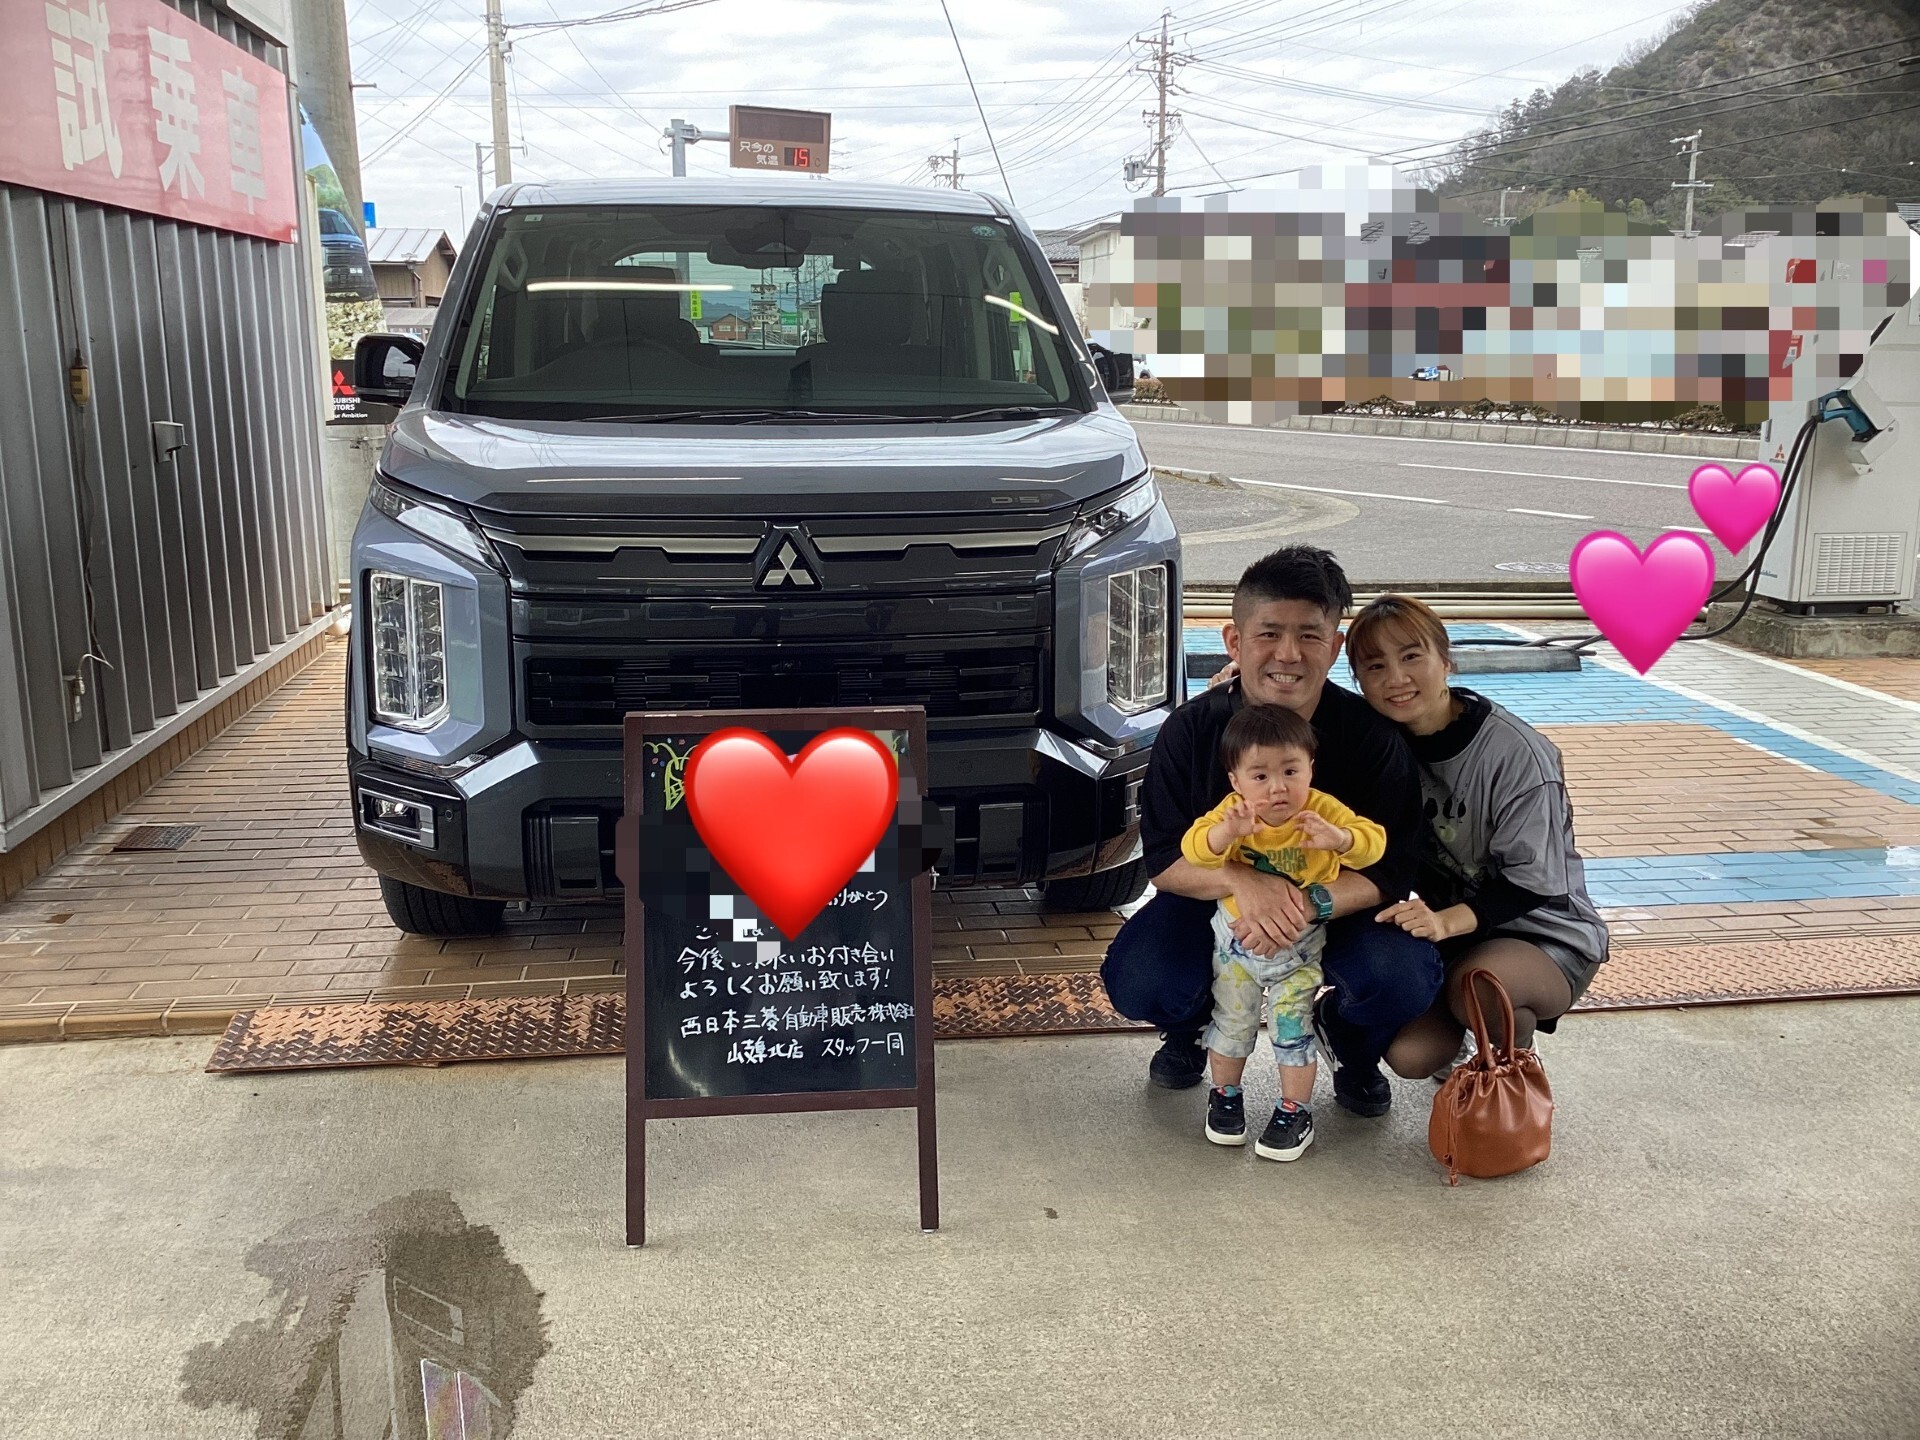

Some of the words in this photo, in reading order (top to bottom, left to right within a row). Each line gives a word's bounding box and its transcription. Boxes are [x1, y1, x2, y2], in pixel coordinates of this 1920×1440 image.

[45, 0, 267, 215] 試乗車
[739, 141, 774, 153] 只今の
[756, 154, 779, 166] 気温
[793, 148, 809, 167] 15
